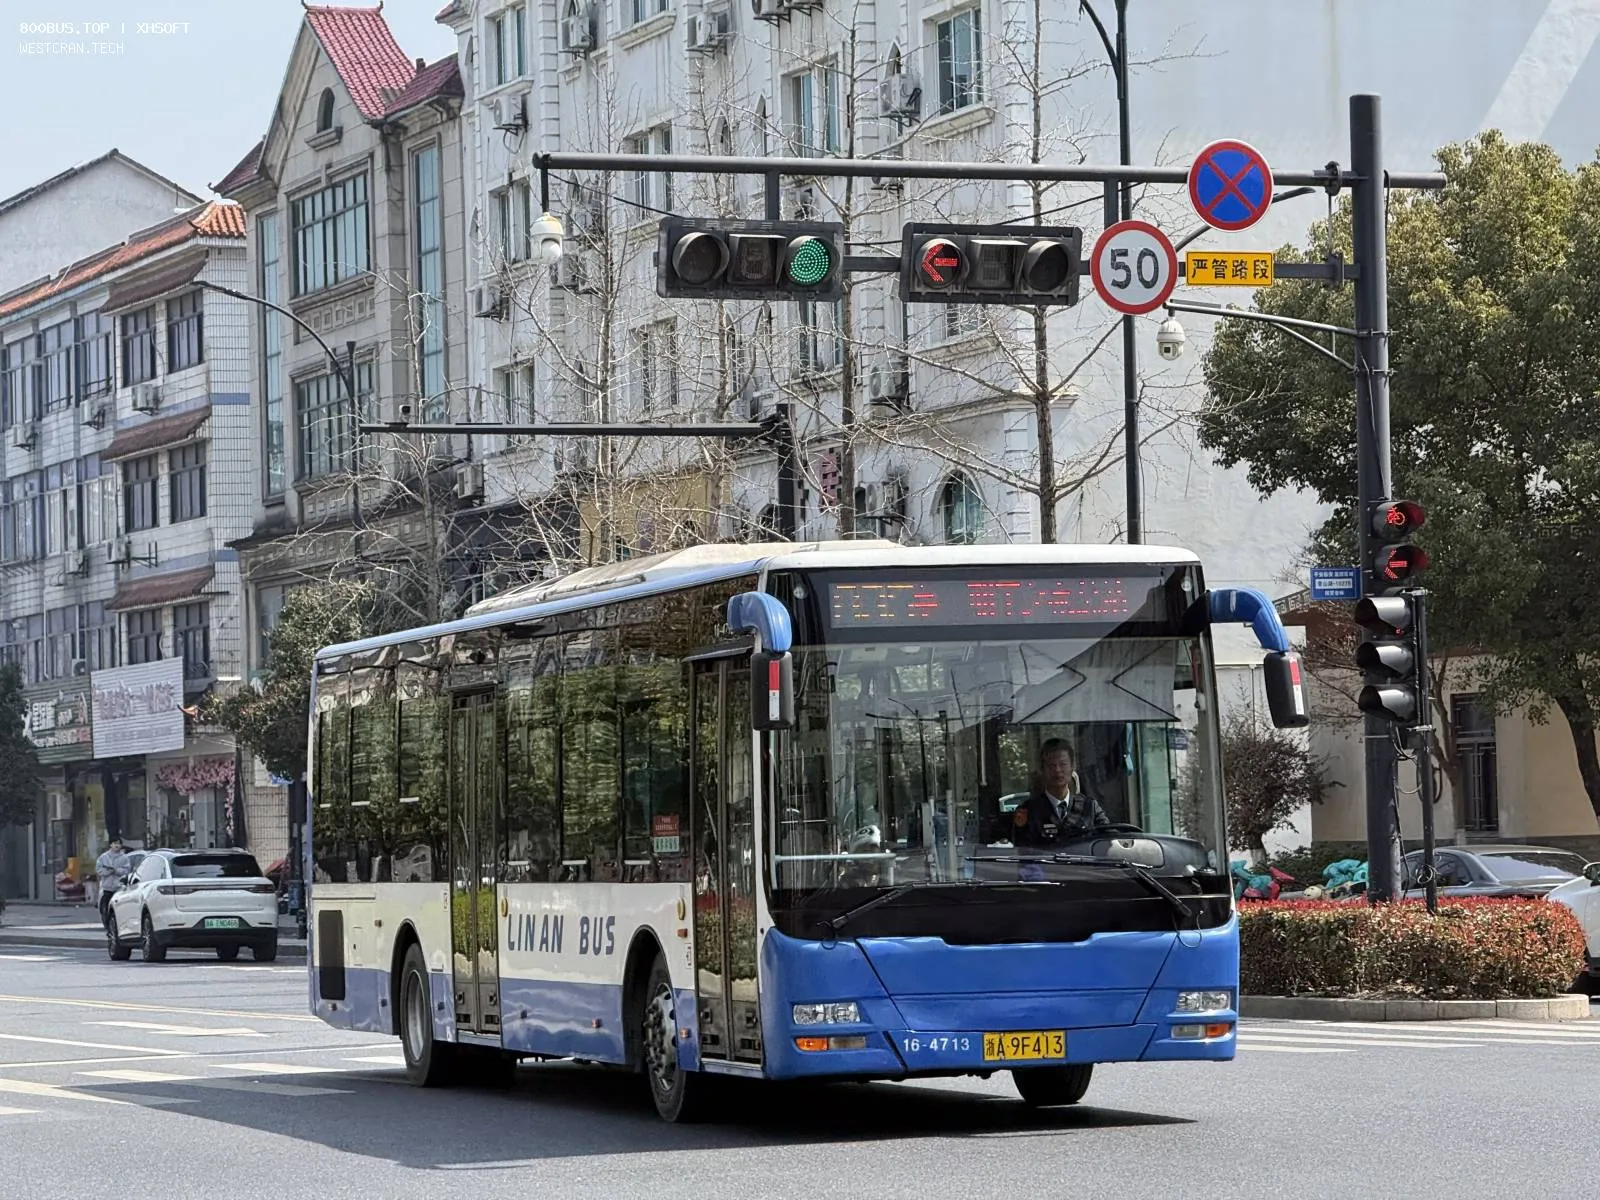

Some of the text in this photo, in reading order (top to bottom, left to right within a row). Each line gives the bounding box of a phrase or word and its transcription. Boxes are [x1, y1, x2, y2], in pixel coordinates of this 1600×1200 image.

[1110, 247, 1160, 290] 50
[1191, 258, 1270, 280] 严管路段
[507, 913, 616, 956] LINAN BUS
[903, 1038, 970, 1052] 16-4713
